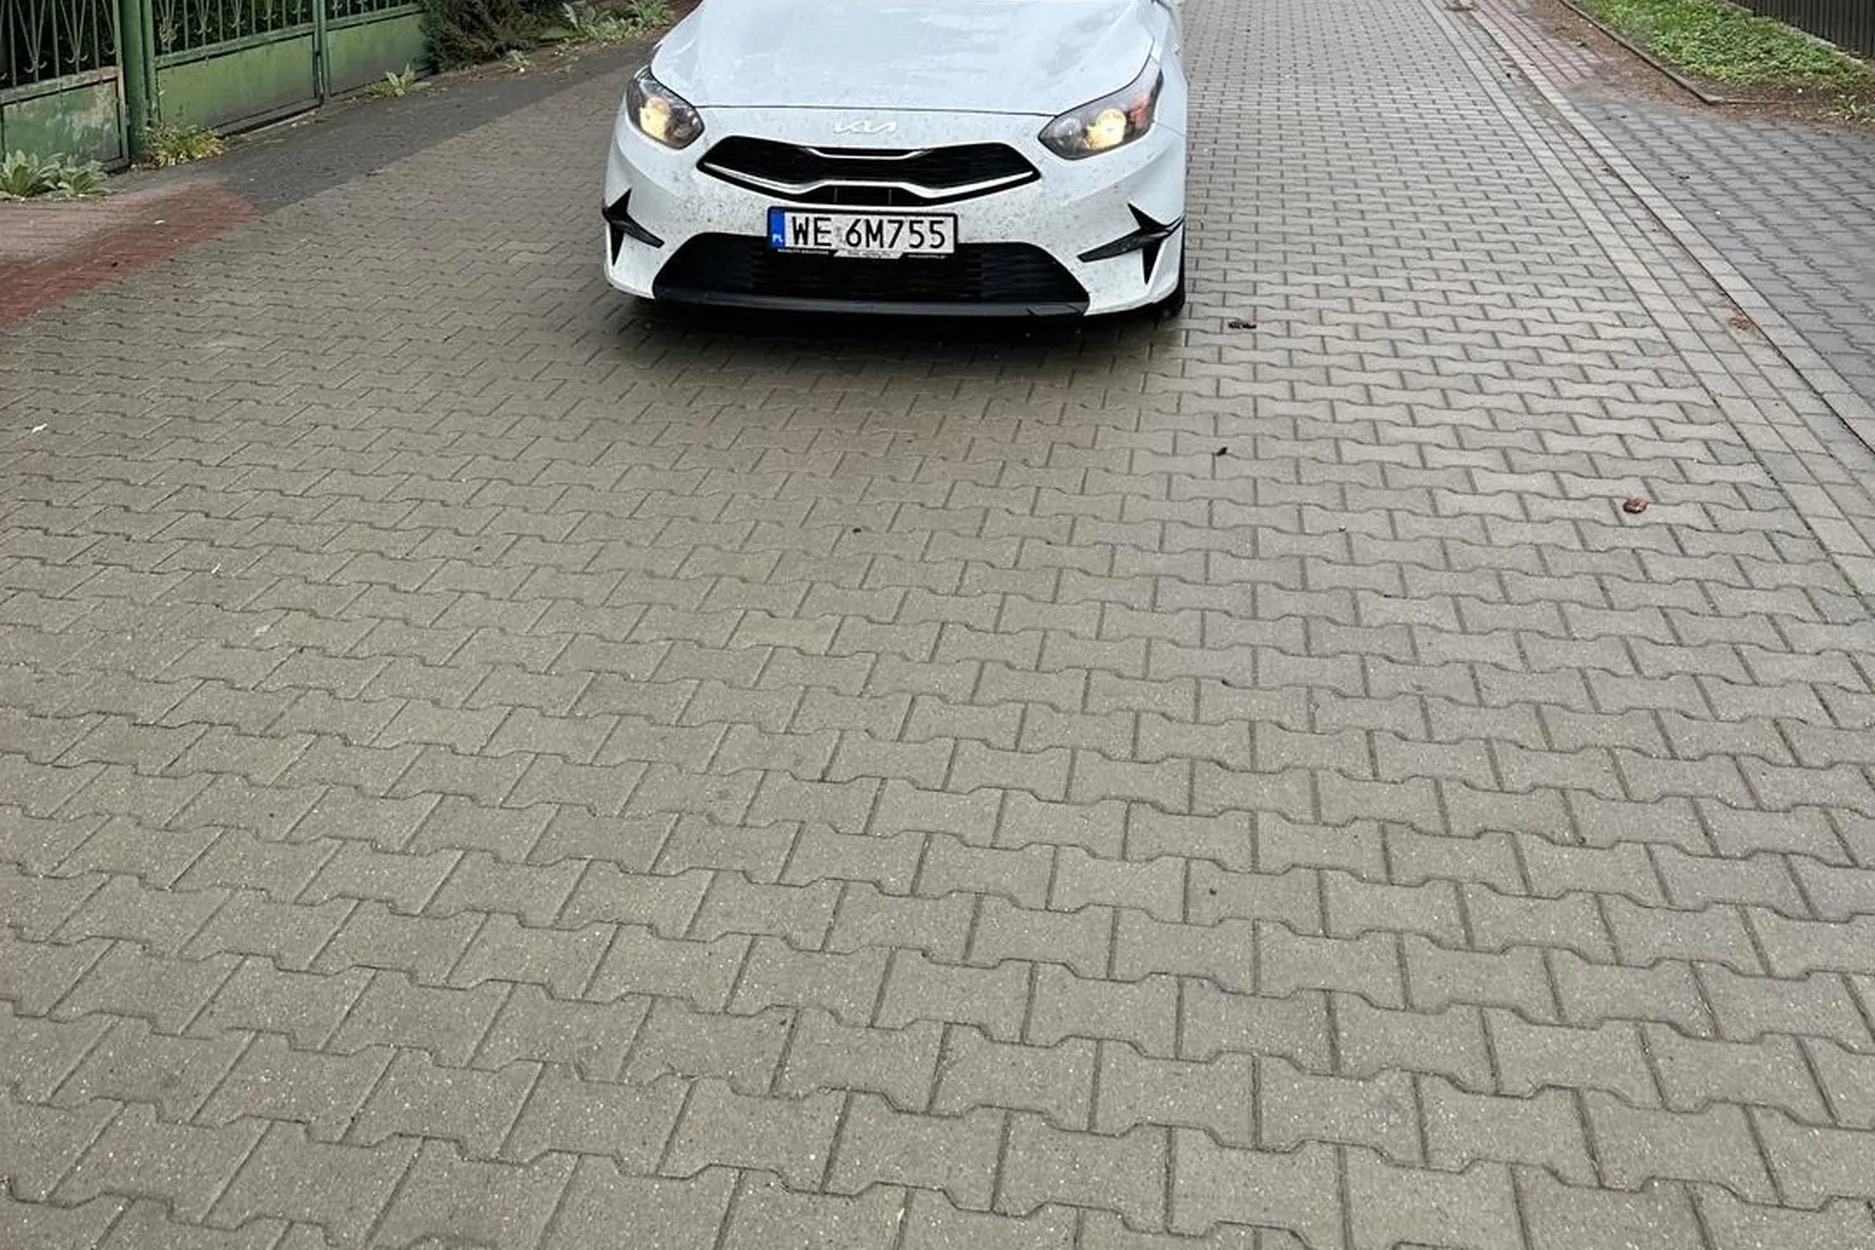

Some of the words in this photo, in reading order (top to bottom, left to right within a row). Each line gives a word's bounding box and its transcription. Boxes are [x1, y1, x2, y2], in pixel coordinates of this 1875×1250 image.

[772, 233, 783, 242] PL
[791, 216, 832, 247] WE
[845, 218, 945, 249] 6M755
